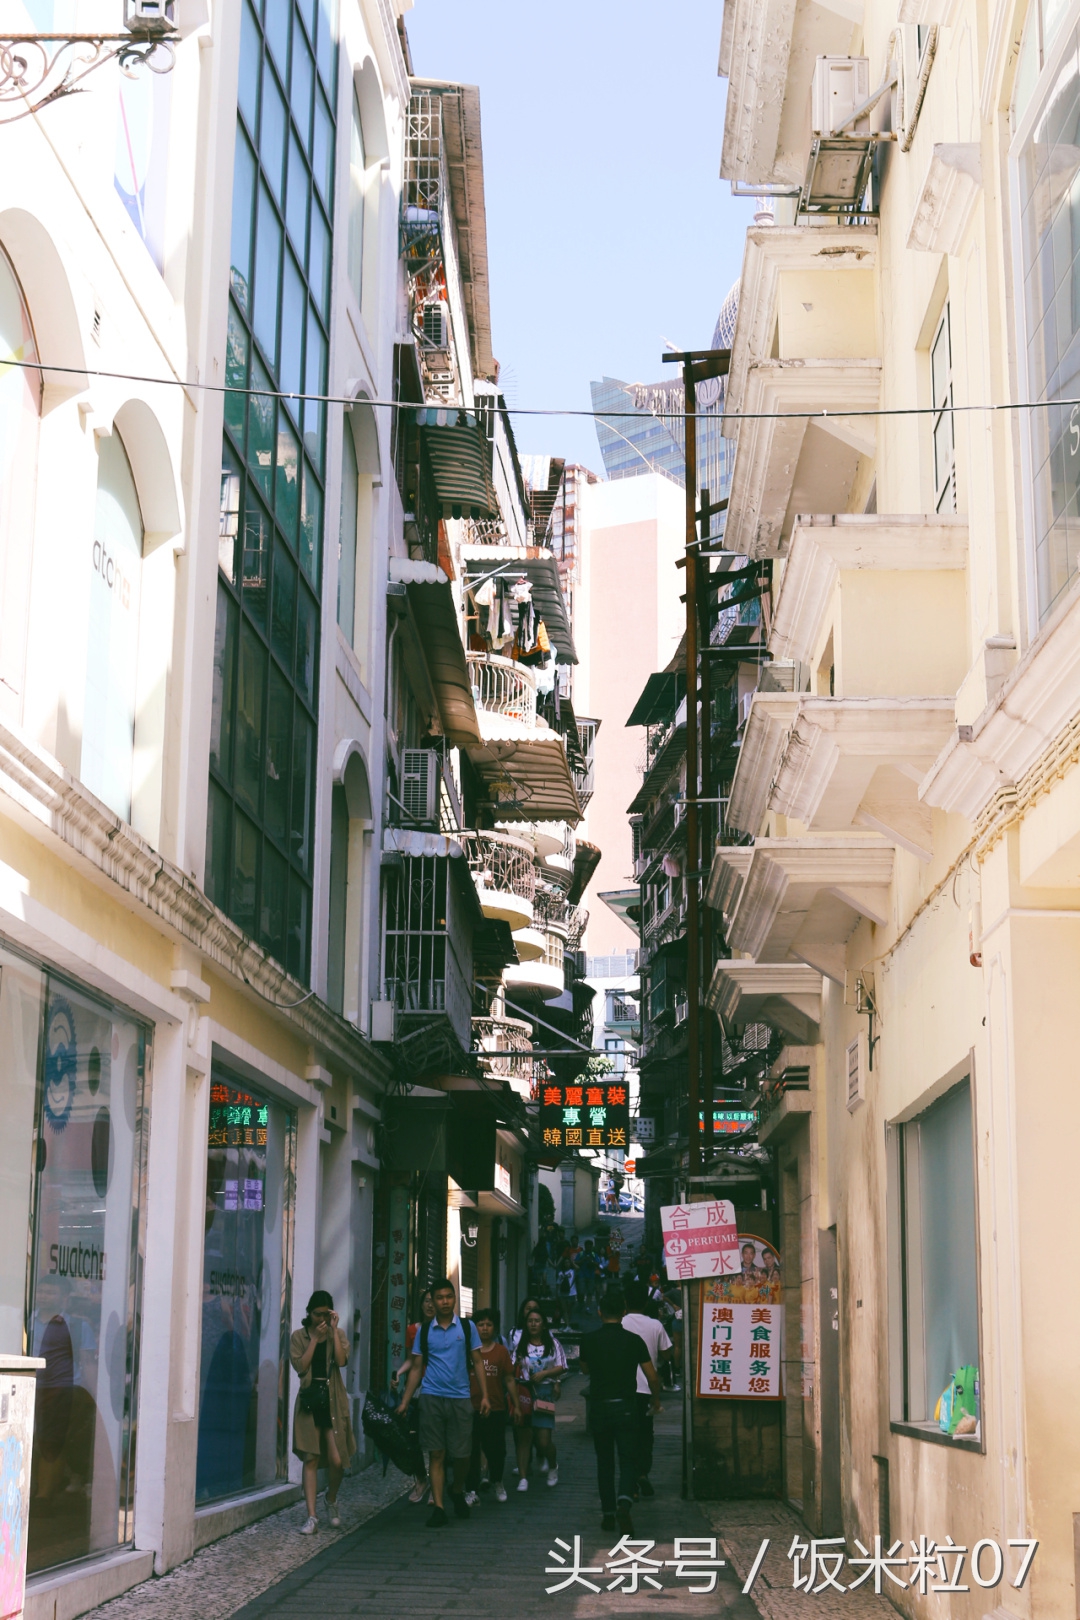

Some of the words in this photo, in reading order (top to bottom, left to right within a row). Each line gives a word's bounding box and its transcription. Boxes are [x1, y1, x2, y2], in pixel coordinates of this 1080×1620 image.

[543, 1085, 626, 1106] 美麗童裝
[562, 1107, 606, 1126] 專營
[543, 1128, 626, 1147] 韓國直送
[669, 1201, 728, 1230] 合成
[688, 1233, 737, 1247] PERFUME
[50, 1241, 102, 1280] swatch
[674, 1251, 734, 1279] 香水
[709, 1307, 734, 1392] 澳门好運站
[748, 1308, 772, 1393] 美食服务您
